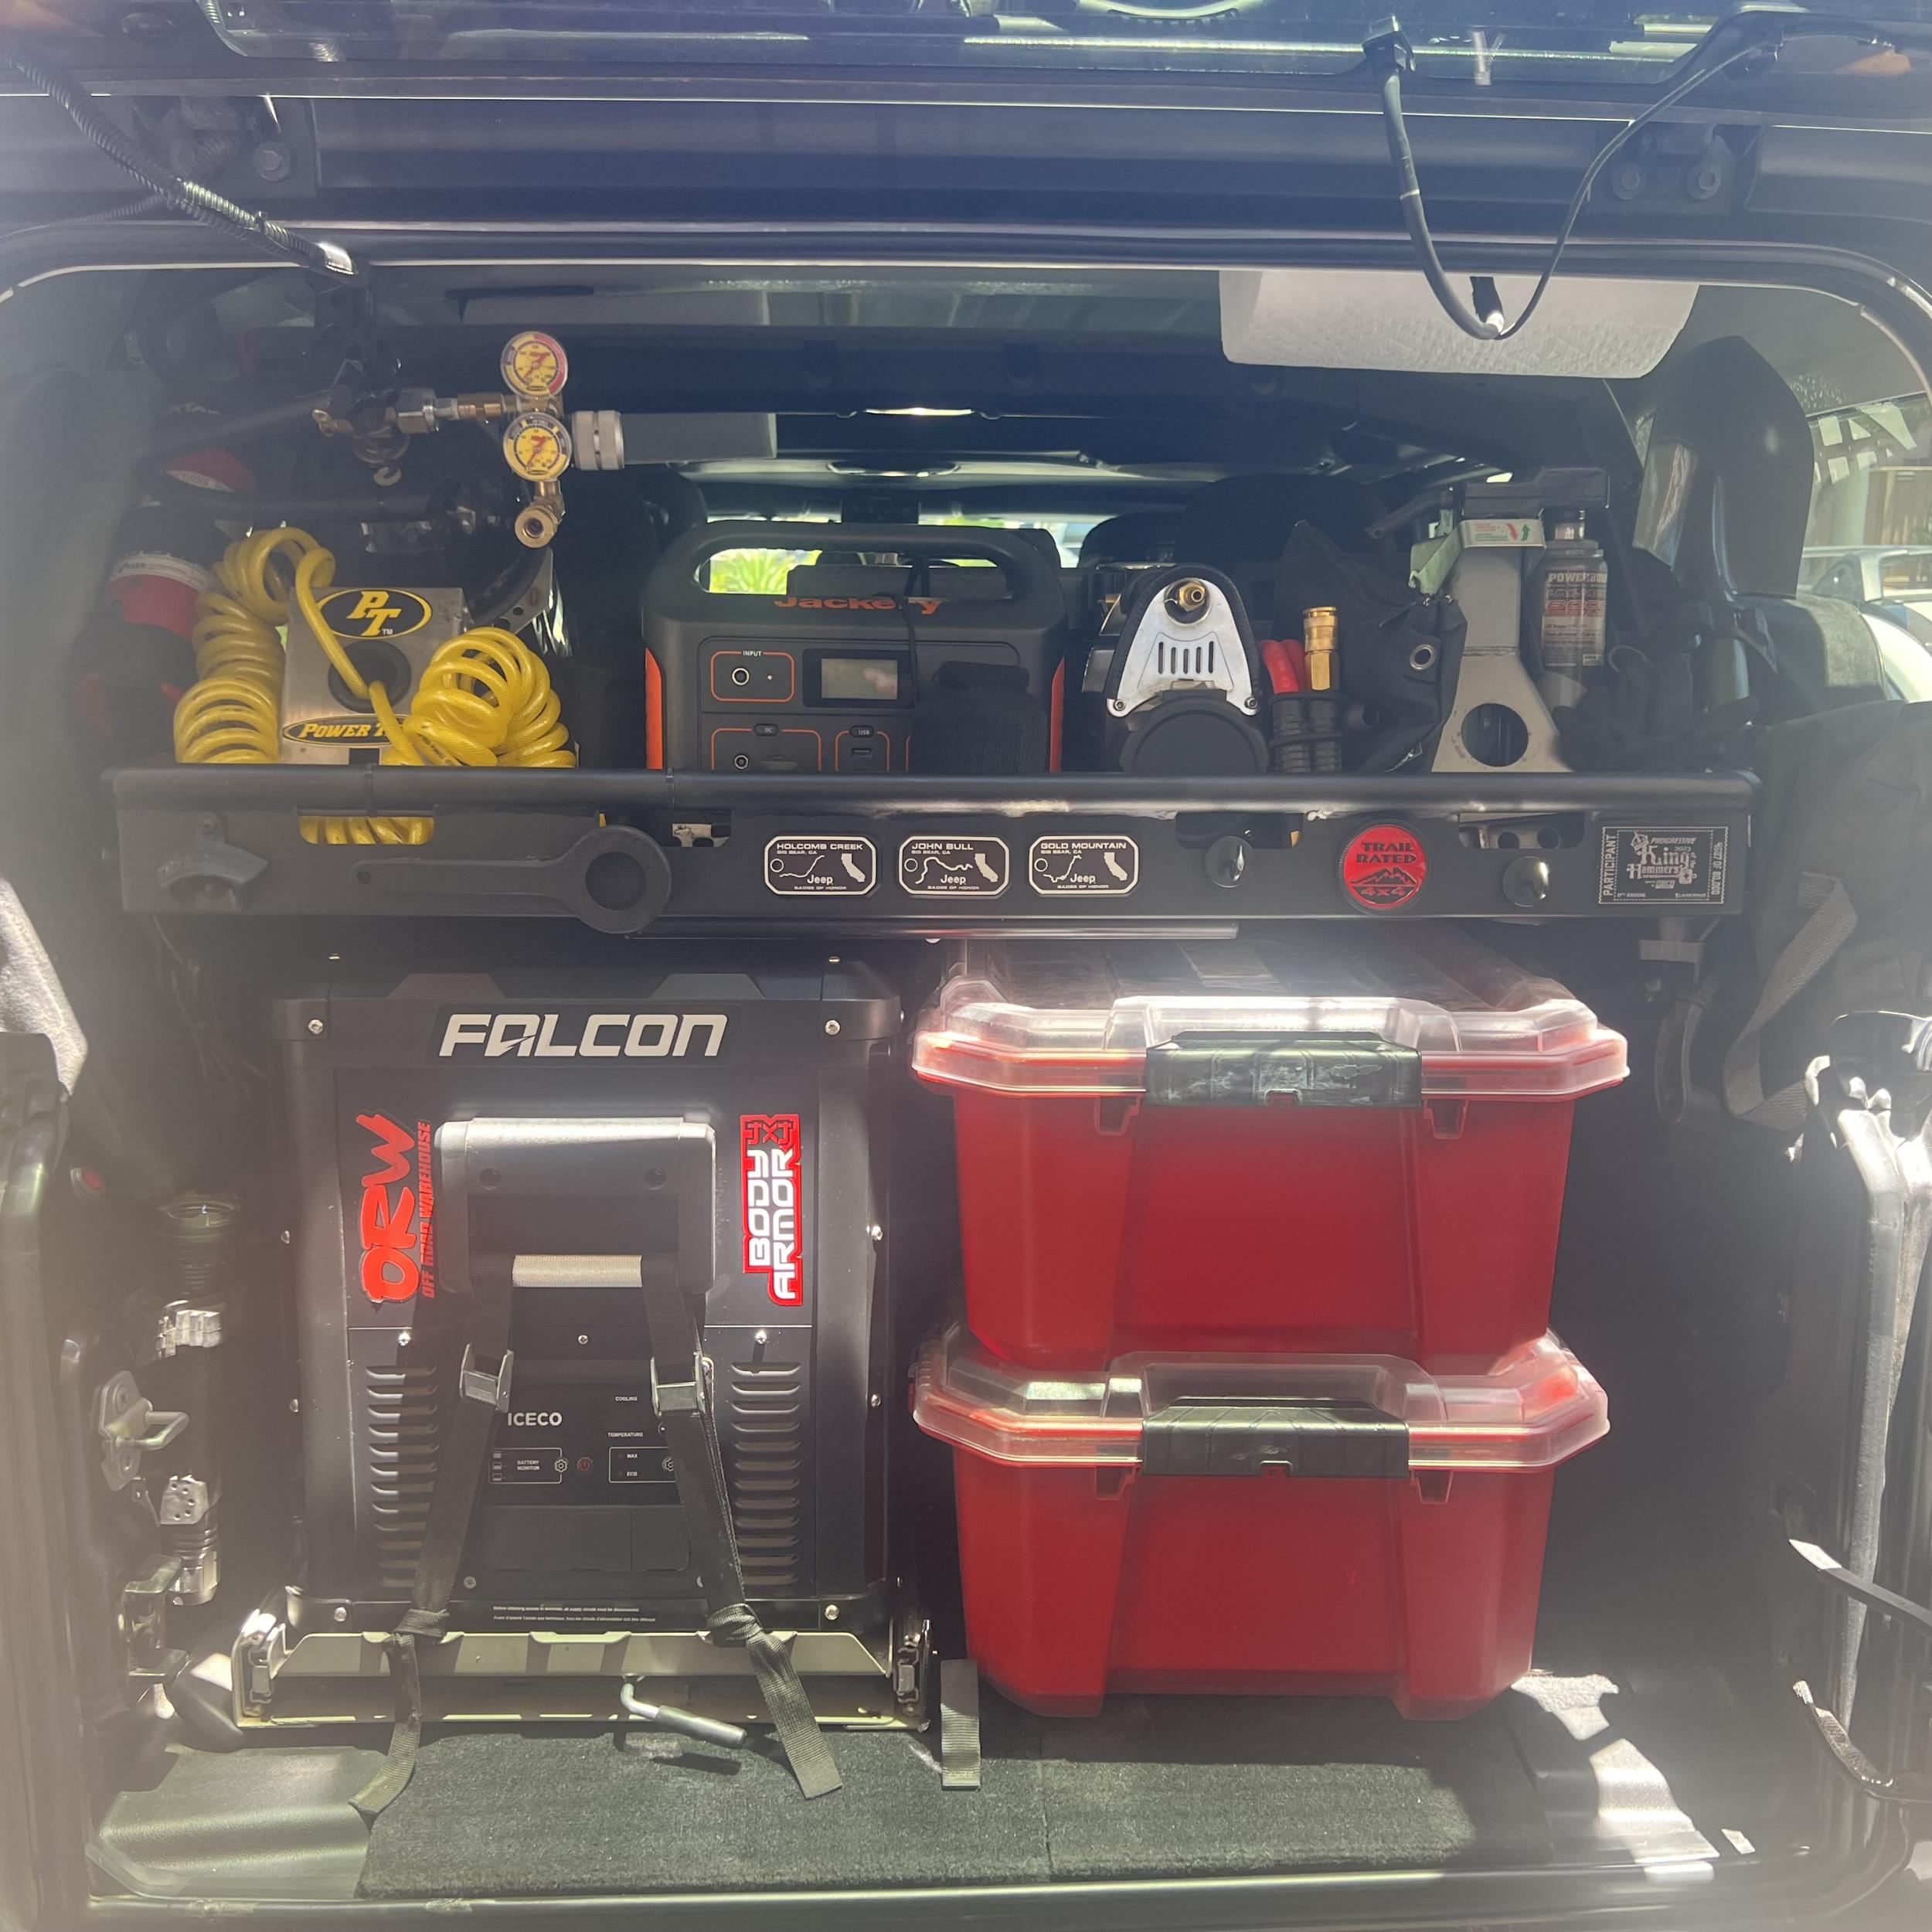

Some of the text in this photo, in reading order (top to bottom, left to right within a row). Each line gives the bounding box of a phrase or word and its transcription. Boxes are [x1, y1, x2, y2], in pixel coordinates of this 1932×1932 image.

[774, 596, 941, 615] Jackey
[298, 723, 372, 739] POWER
[1362, 842, 1415, 852] TRAIL
[1356, 853, 1417, 863] RATED
[1604, 834, 1617, 896] PARTICIPANT
[807, 874, 834, 886] Jeep
[940, 874, 967, 886] Jeep
[1070, 873, 1097, 885] Jeep
[438, 1013, 728, 1057] FALCON
[355, 1114, 420, 1301] ORW
[417, 1121, 436, 1299] OFF ROAD WAREHOUSE
[747, 1148, 770, 1267] BODY
[771, 1148, 797, 1300] ARMOR
[507, 1412, 563, 1427] ICECO
